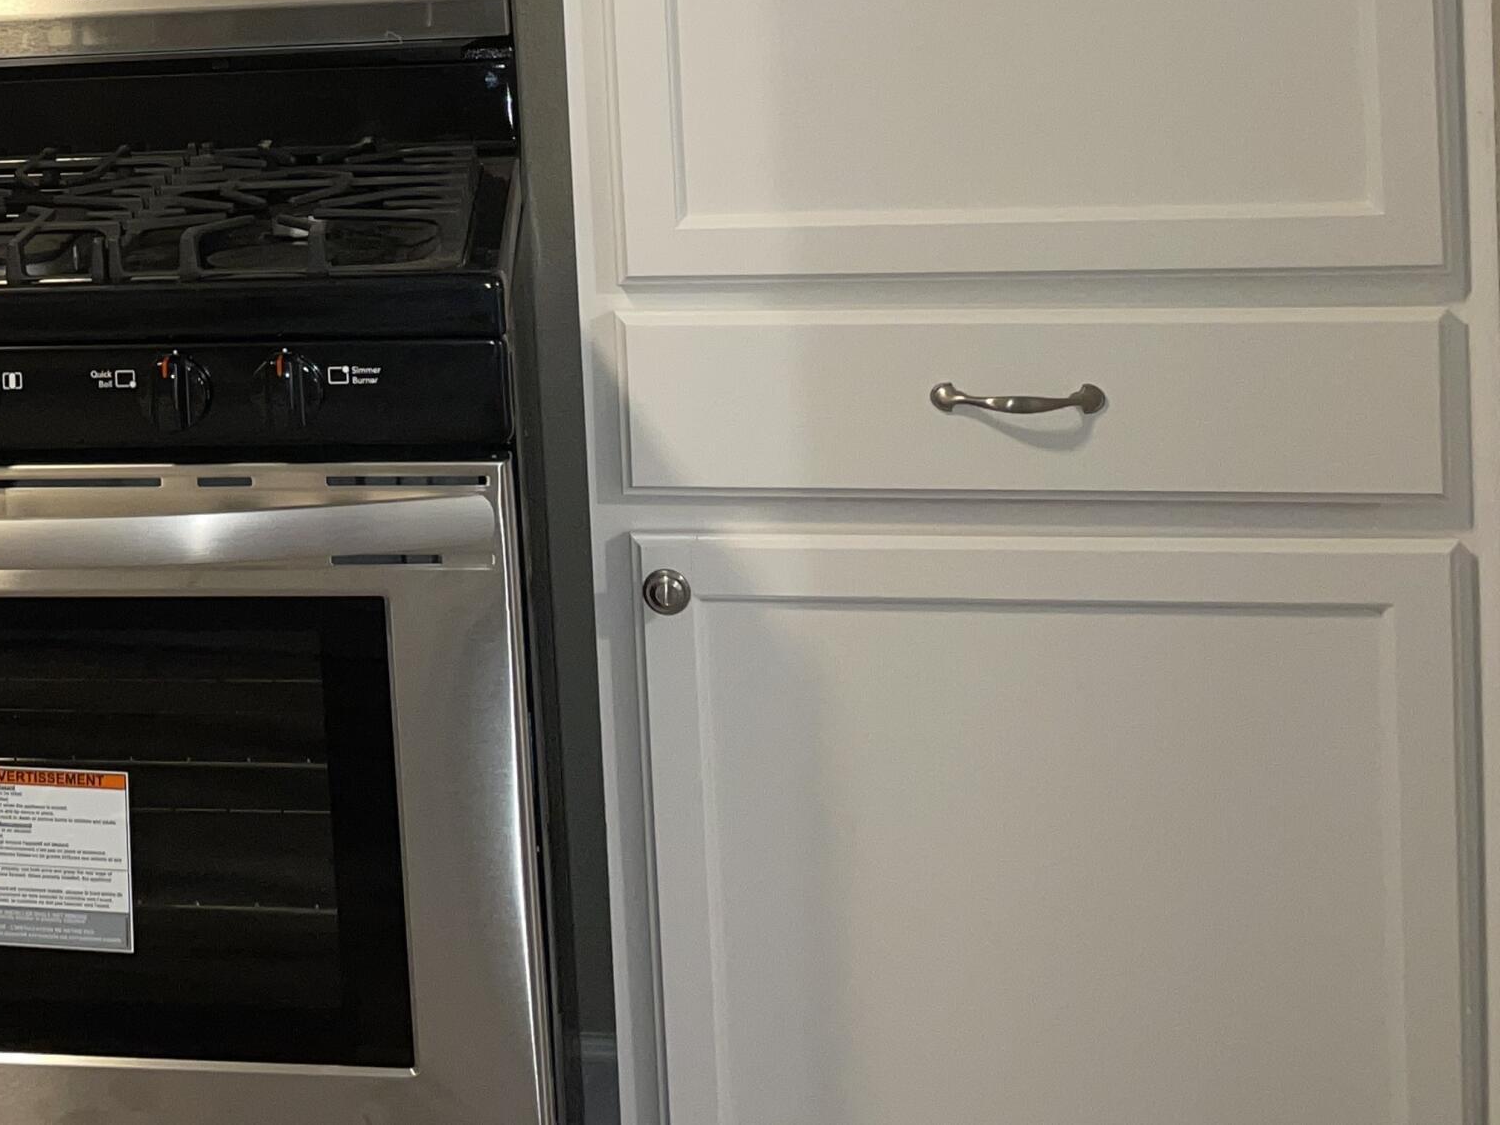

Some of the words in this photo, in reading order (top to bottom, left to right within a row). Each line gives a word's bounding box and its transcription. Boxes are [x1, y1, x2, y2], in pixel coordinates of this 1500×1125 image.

[351, 365, 381, 374] Simmer
[90, 370, 112, 379] Quick
[98, 379, 113, 388] Boil
[352, 376, 378, 385] Burner
